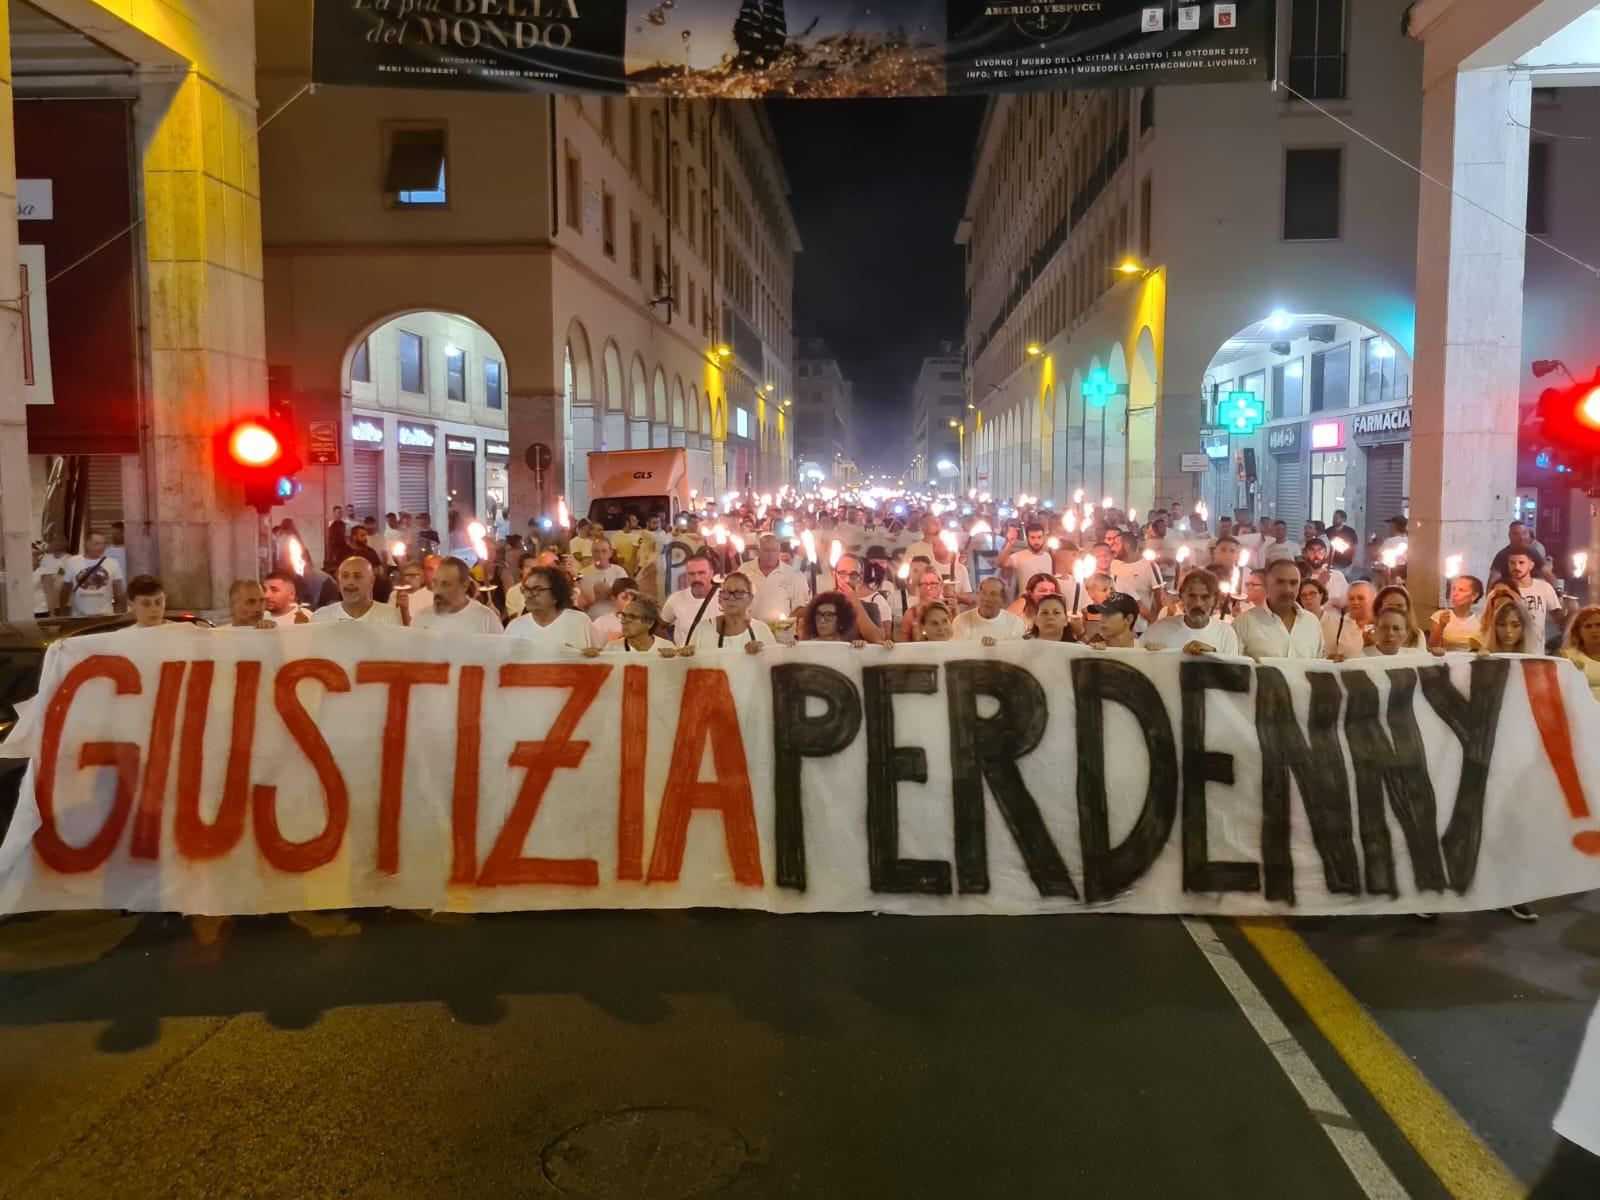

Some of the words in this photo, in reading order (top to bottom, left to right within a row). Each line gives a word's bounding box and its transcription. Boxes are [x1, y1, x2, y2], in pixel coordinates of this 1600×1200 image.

[985, 5, 1040, 15] AMERIGO
[1044, 3, 1101, 13] VESPUCCI
[366, 18, 408, 44] del
[419, 18, 572, 49] MONDO
[975, 58, 1013, 67] LIVORNO
[1021, 57, 1052, 66] MUSEO
[1127, 52, 1163, 60] AGOSTO
[1185, 49, 1226, 57] OTTOBRE
[1229, 47, 1249, 55] 2022
[1353, 409, 1411, 433] FARMACIA
[633, 471, 653, 479] GLS
[31, 655, 765, 888] GIUSTIZIA
